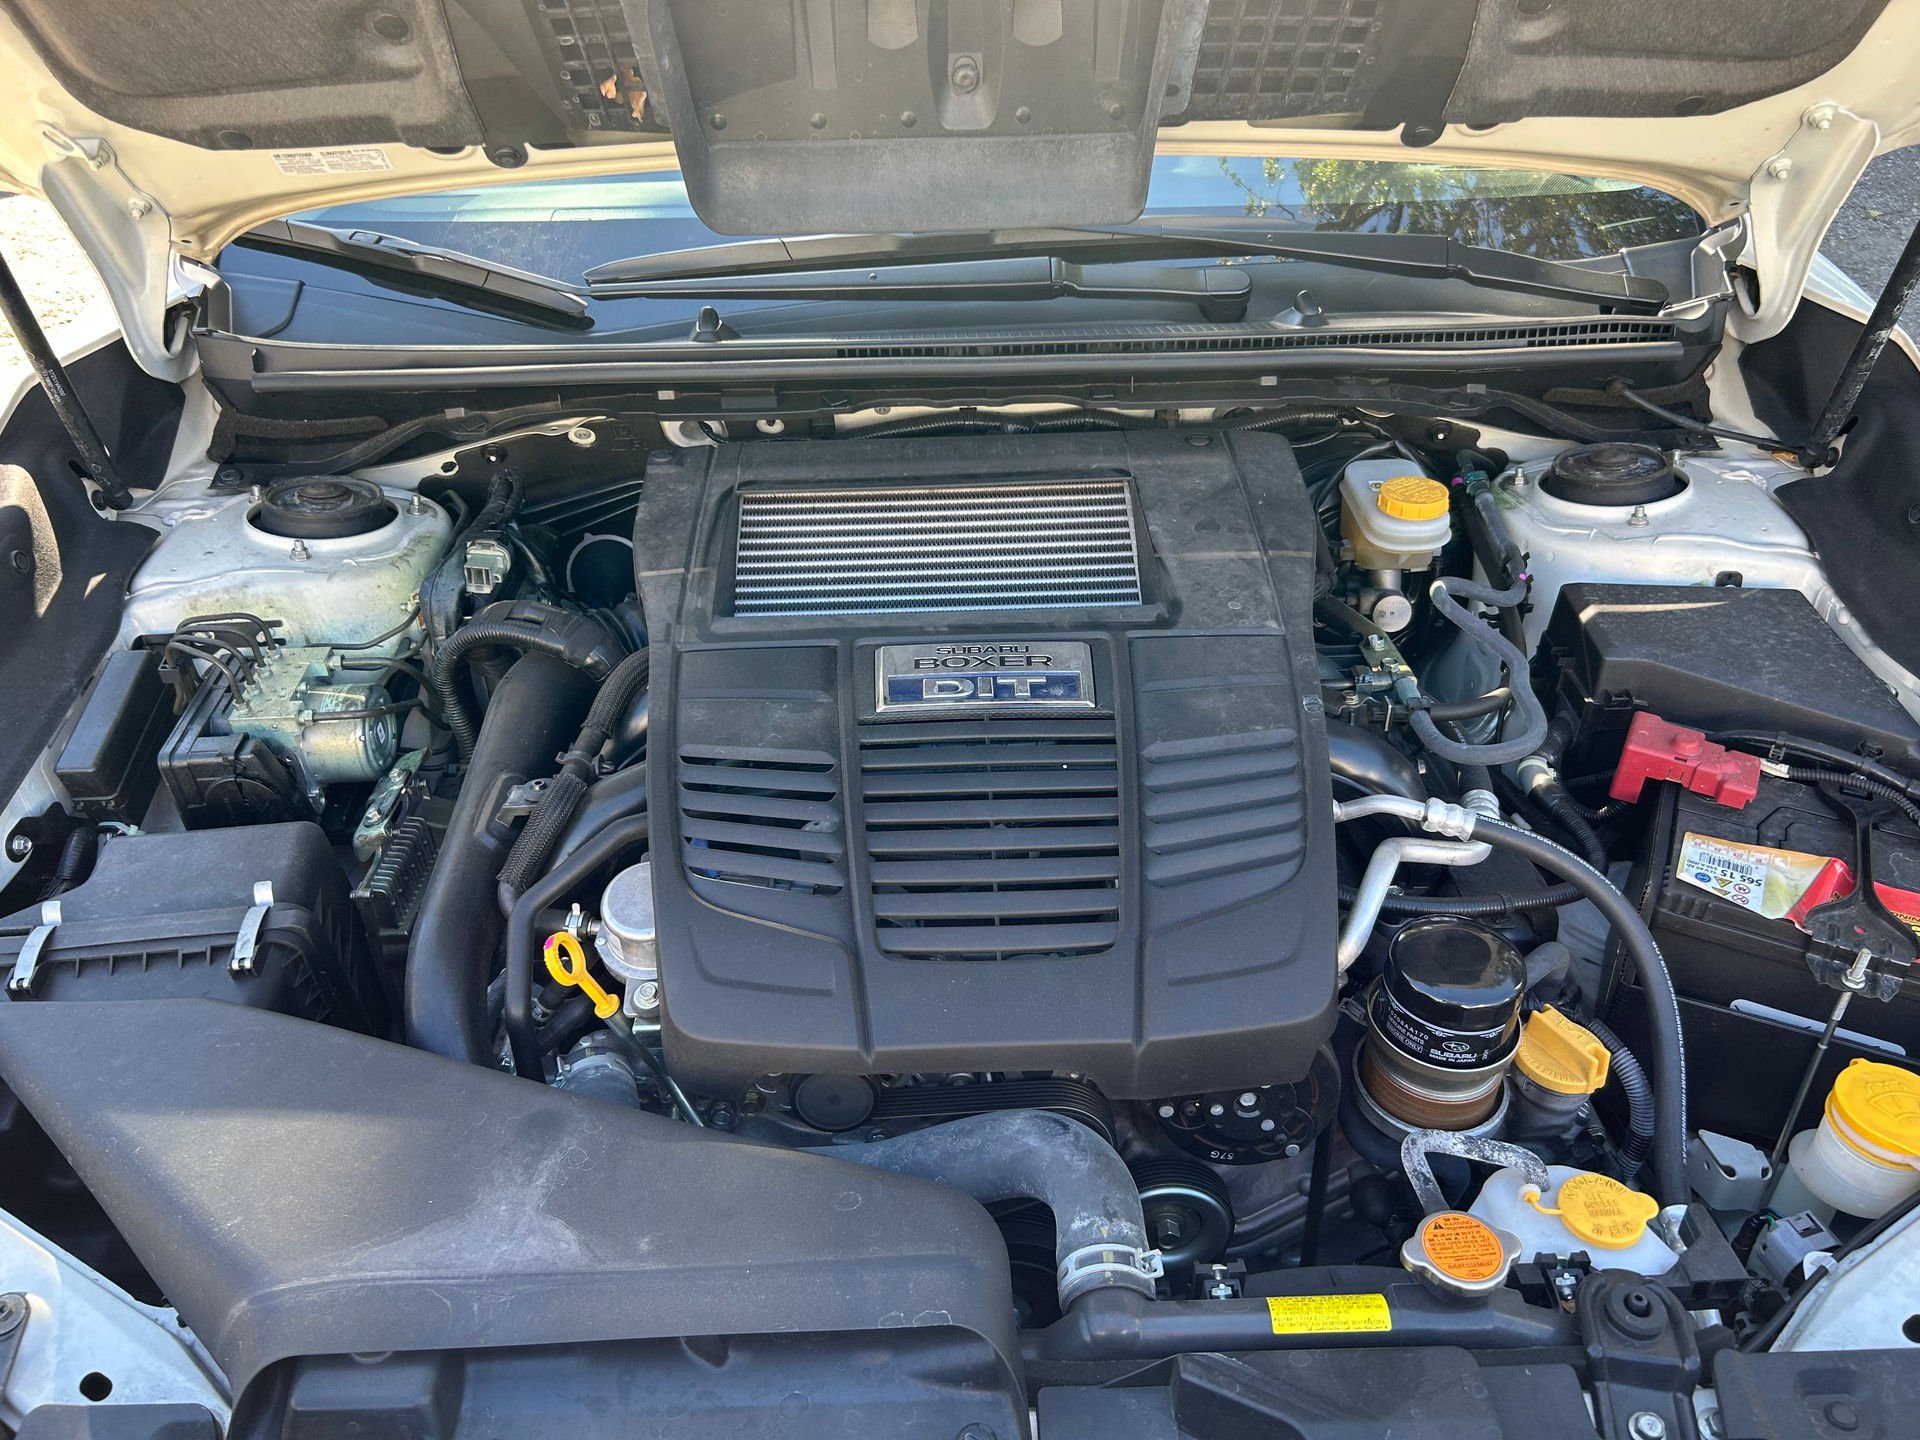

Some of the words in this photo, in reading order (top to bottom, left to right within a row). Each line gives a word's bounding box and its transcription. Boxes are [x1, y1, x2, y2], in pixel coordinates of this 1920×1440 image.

[936, 645, 1030, 655] SUBARU
[913, 654, 1053, 669] BOXER
[922, 676, 1047, 699] DIT
[1720, 869, 1736, 880] 15
[1740, 874, 1763, 887] 565
[1406, 1031, 1424, 1045] PARTS
[1404, 1040, 1422, 1052] ONLY
[1429, 1053, 1447, 1061] MADE
[1430, 1048, 1477, 1058] SUBARU
[1210, 1150, 1234, 1160] 57G
[1562, 1175, 1628, 1200] COOLANT
